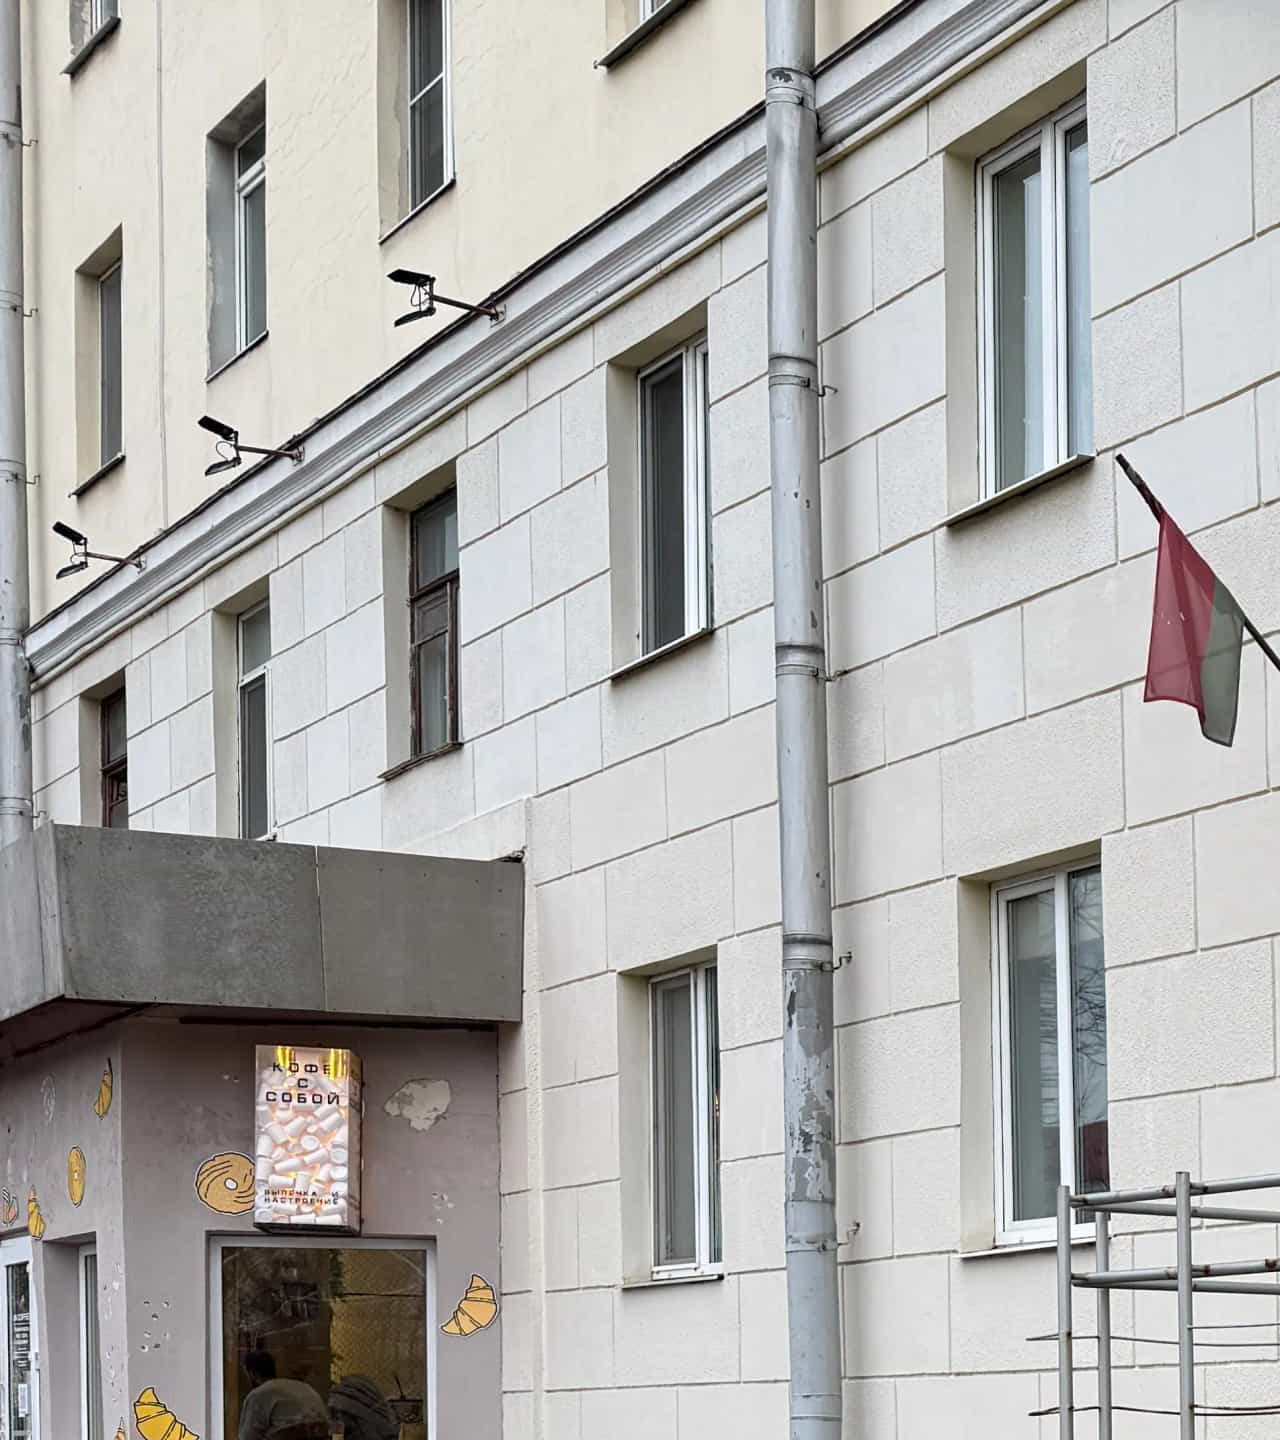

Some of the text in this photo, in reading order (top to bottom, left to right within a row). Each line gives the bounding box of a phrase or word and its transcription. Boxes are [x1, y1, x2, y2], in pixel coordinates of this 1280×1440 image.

[272, 1061, 332, 1075] КОФЕ
[297, 1078, 308, 1089] С
[265, 1090, 340, 1105] СОБОЙ
